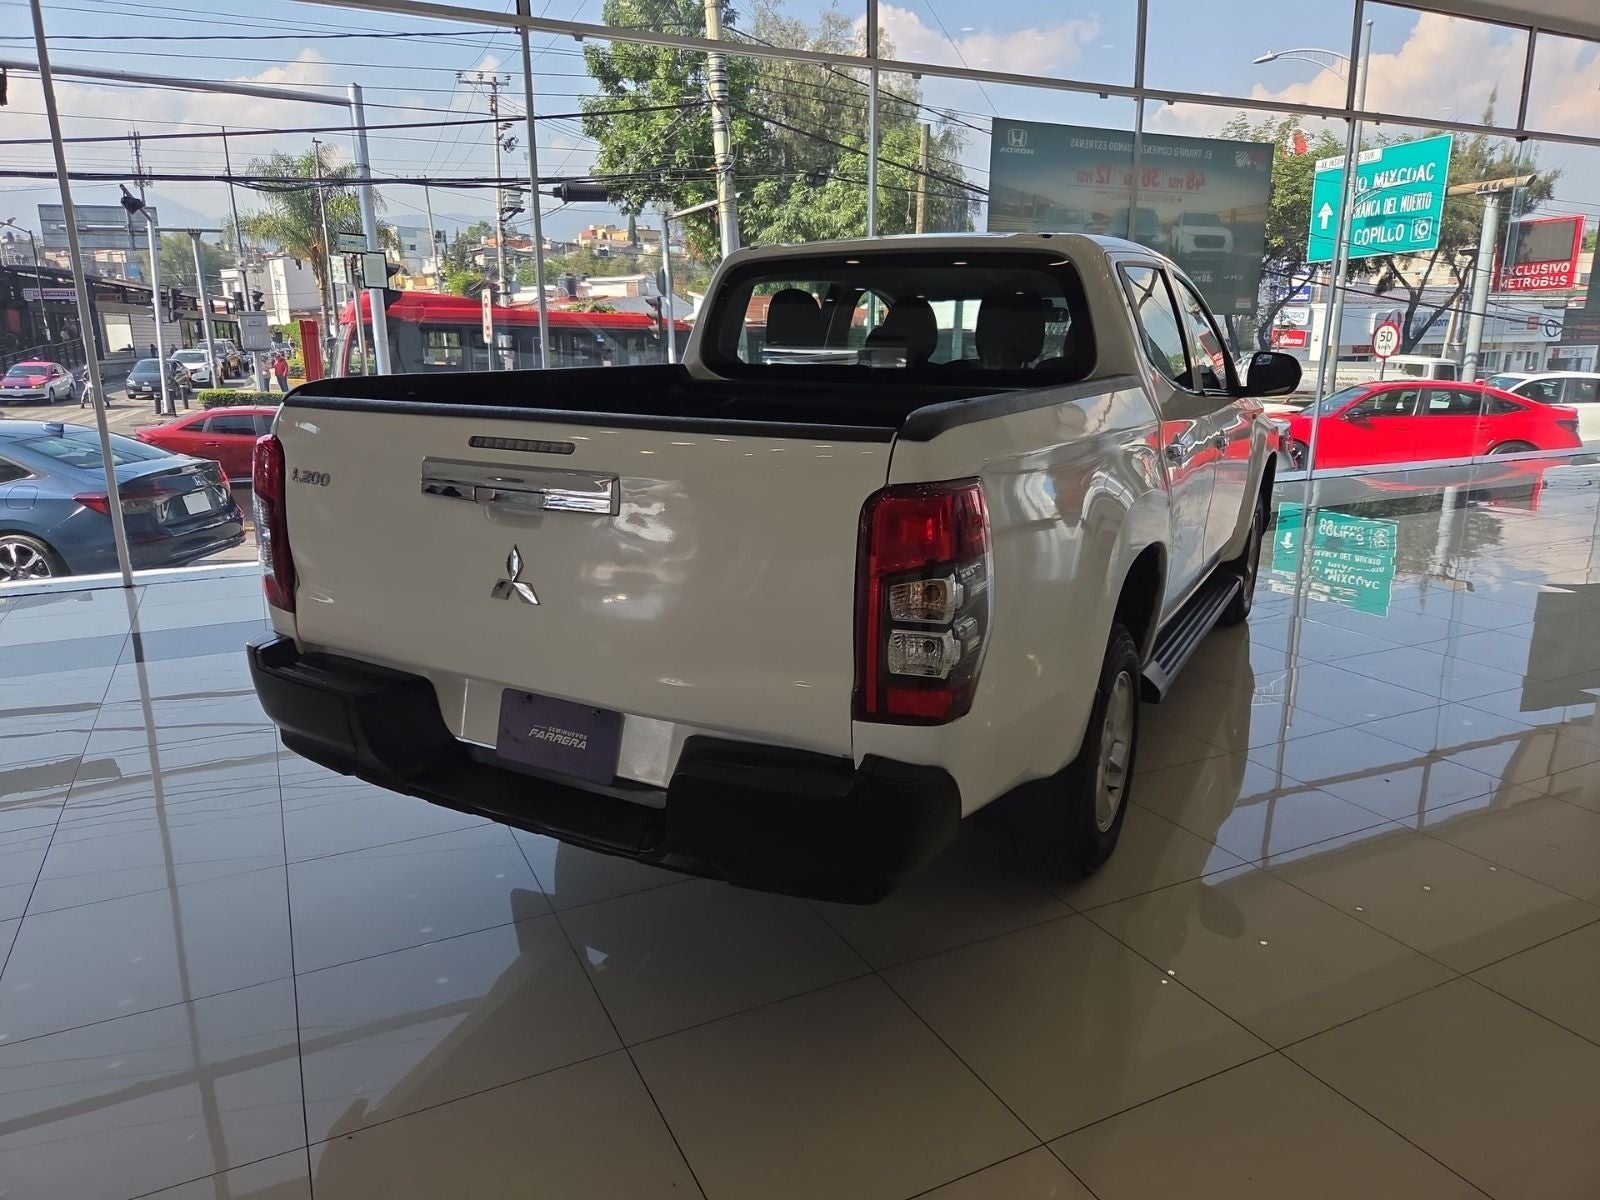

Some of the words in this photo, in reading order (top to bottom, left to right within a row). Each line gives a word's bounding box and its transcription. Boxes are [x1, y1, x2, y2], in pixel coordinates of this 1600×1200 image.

[1372, 162, 1436, 189] MIXCOAC
[1383, 197, 1398, 215] DEL
[1400, 191, 1432, 213] MUERTO
[1354, 223, 1405, 246] COPILCO
[1501, 262, 1571, 277] EXCLUSIVO
[1500, 274, 1568, 289] METROBUS
[1379, 331, 1393, 342] 50
[528, 728, 588, 750] FARRERA
[548, 726, 588, 740] SEMINUEVOS
